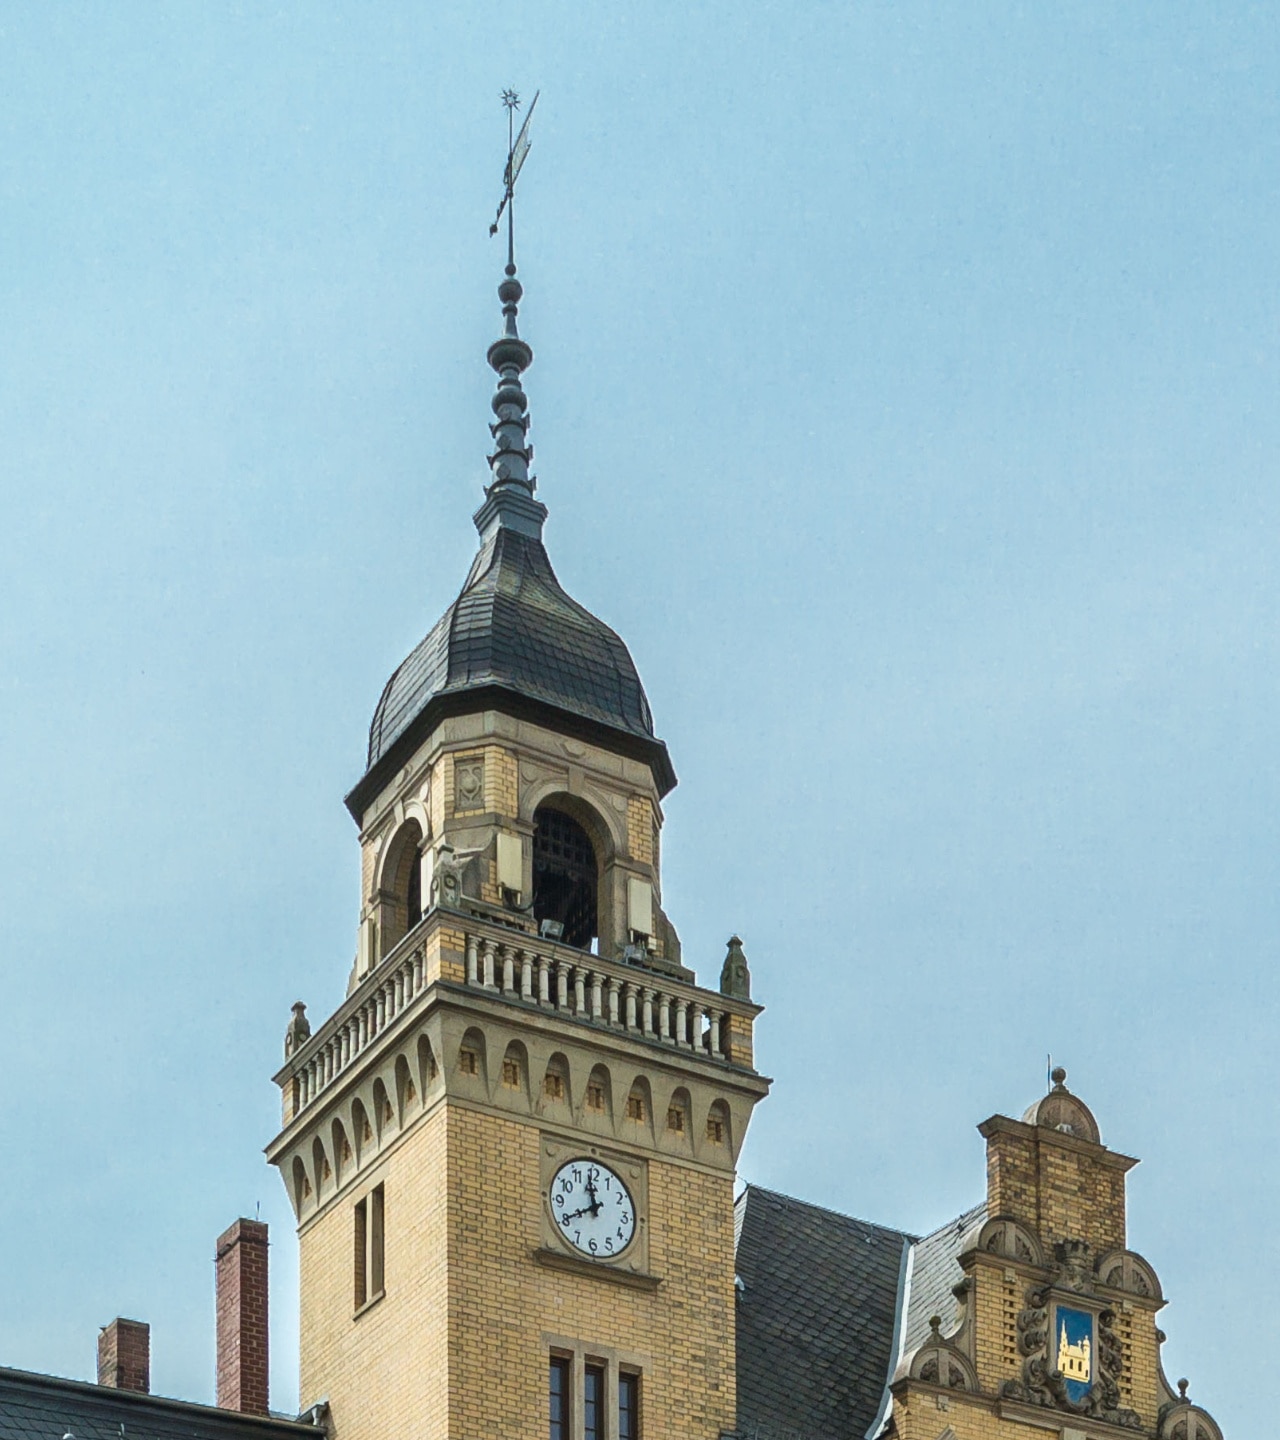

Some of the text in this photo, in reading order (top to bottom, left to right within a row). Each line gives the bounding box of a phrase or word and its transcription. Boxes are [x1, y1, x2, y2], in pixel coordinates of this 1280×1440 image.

[572, 1169, 582, 1183] 11
[588, 1168, 600, 1182] 12
[561, 1179, 573, 1193] 10
[605, 1178, 610, 1191] 1
[556, 1194, 564, 1207] 9
[616, 1192, 623, 1205] 2
[562, 1213, 570, 1226] 8
[621, 1211, 628, 1224] 3
[574, 1230, 581, 1244] 7
[616, 1227, 623, 1240] 4
[588, 1238, 597, 1251] 6
[604, 1237, 613, 1251] 5
